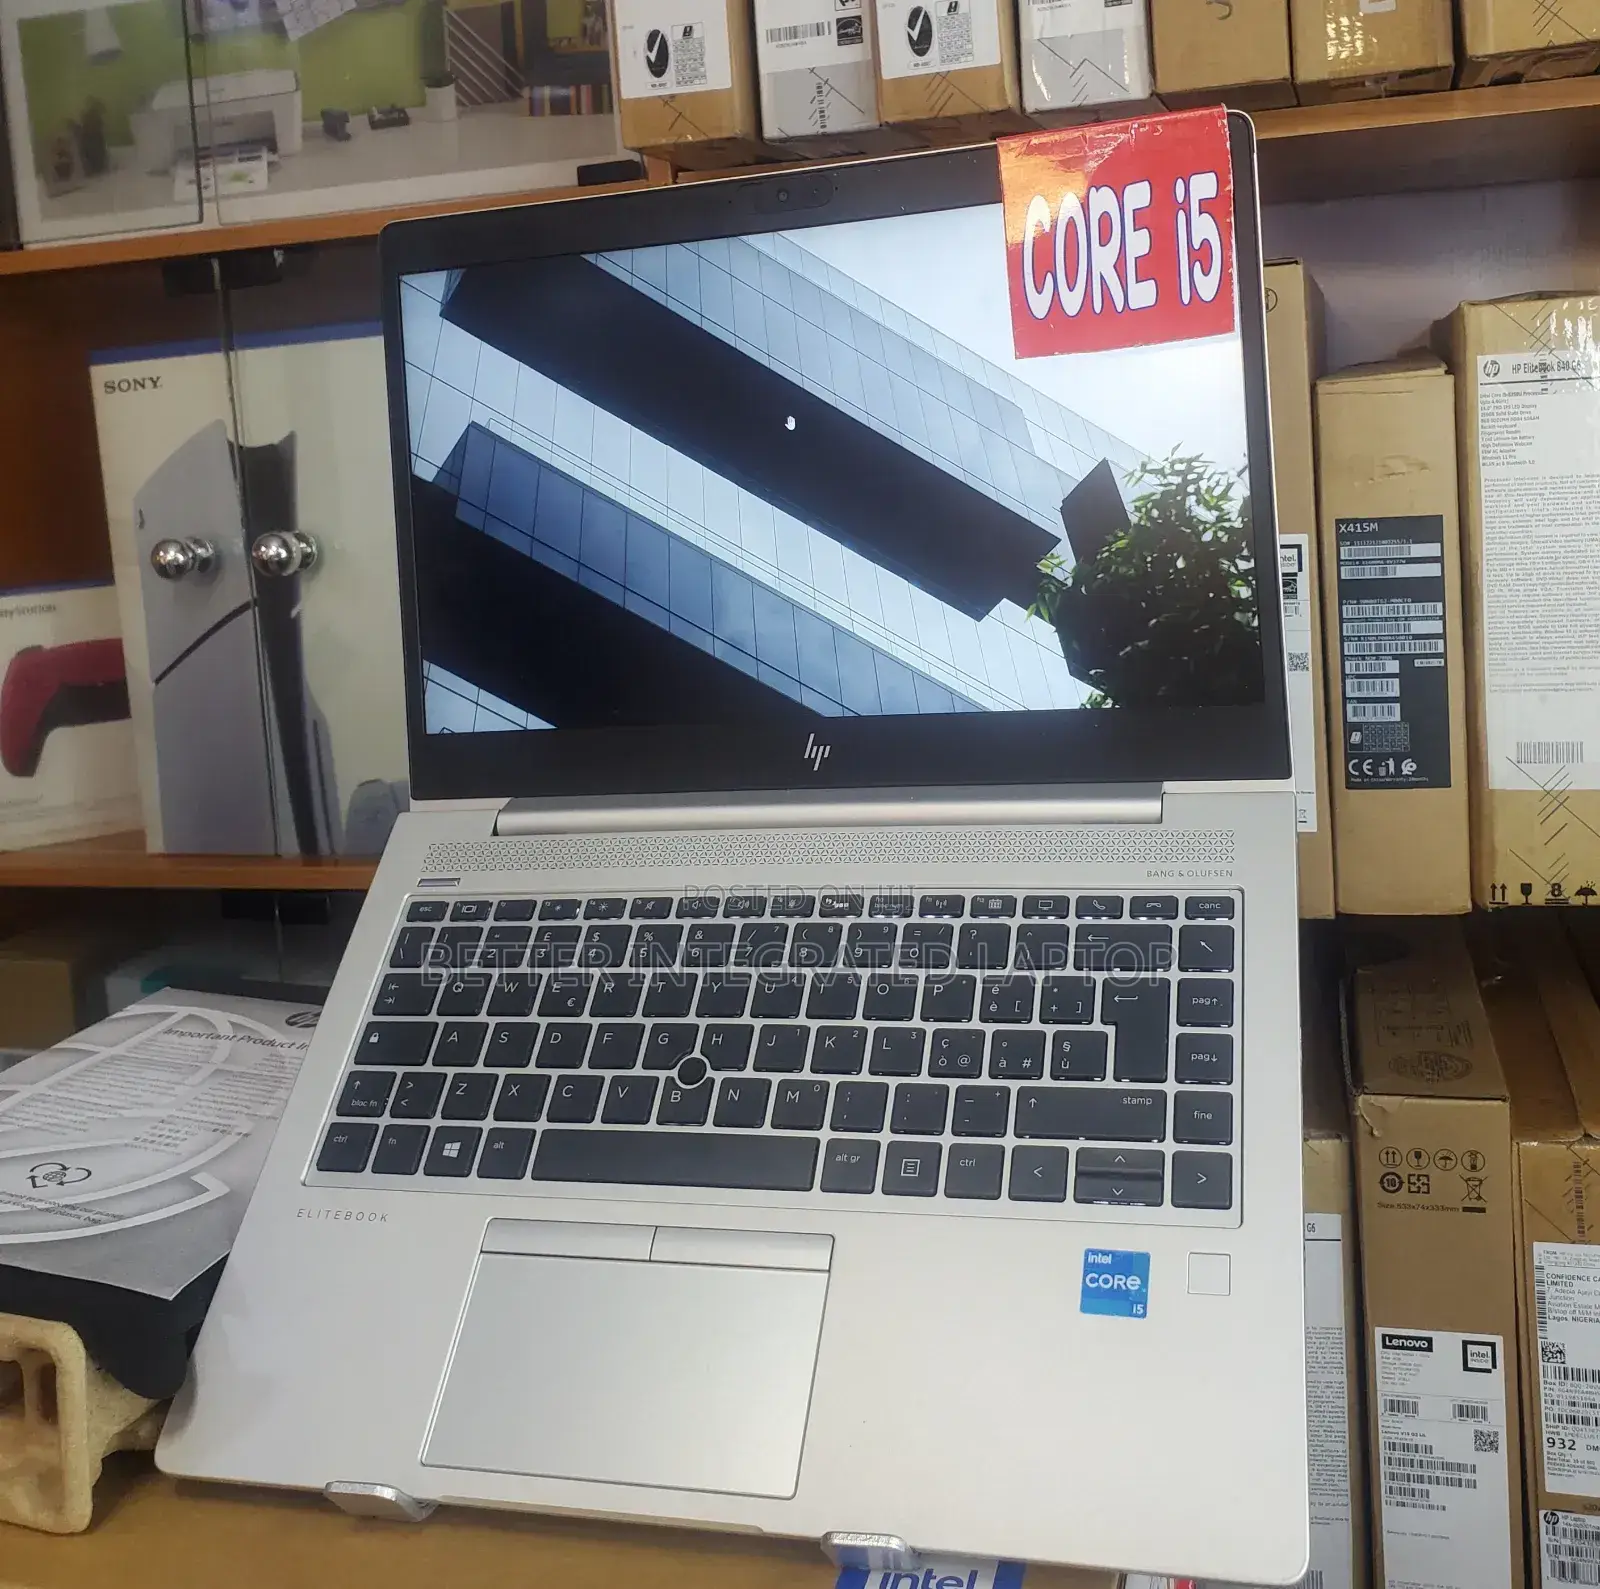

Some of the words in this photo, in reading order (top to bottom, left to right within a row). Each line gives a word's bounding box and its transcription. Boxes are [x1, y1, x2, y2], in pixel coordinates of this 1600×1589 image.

[1022, 179, 1158, 320] CORE
[1174, 171, 1222, 306] i5
[1512, 364, 1521, 374] HP
[104, 376, 162, 394] SONY
[1339, 522, 1379, 533] X415M
[1279, 554, 1296, 562] ntel.
[1146, 870, 1174, 878] BANG
[1178, 870, 1184, 878] &
[1187, 870, 1233, 878] OLUFSEN
[592, 932, 600, 943] $
[643, 931, 654, 942] %
[695, 931, 703, 939] &
[970, 930, 976, 939] ?
[453, 982, 464, 994] Q
[504, 982, 520, 993] W
[552, 982, 563, 993] E
[603, 982, 615, 993] R
[656, 982, 667, 993] T
[711, 982, 722, 993] Y
[764, 983, 776, 994] U
[933, 984, 944, 996] P
[567, 998, 576, 1006] €
[1192, 996, 1211, 1006] pag
[162, 1028, 236, 1041] Important
[237, 1035, 296, 1049] Product
[448, 1032, 457, 1042] A
[499, 1032, 509, 1043] S
[550, 1033, 561, 1043] D
[603, 1033, 613, 1043] F
[658, 1033, 668, 1044] G
[712, 1034, 723, 1044] H
[767, 1035, 775, 1046] J
[825, 1036, 836, 1047] K
[883, 1038, 891, 1049] L
[1063, 1042, 1070, 1052] §
[958, 1055, 970, 1067] @
[1022, 1058, 1031, 1068] #
[1191, 1052, 1210, 1063] pag
[456, 1083, 467, 1094] Z
[509, 1085, 520, 1096] X
[563, 1086, 573, 1097] C
[619, 1087, 628, 1098] V
[671, 1091, 681, 1102] B
[728, 1089, 739, 1100] N
[787, 1091, 799, 1102] M
[1123, 1097, 1152, 1105] stamp
[1194, 1111, 1212, 1119] fine
[835, 1153, 848, 1163] alt
[850, 1154, 861, 1164] gr
[296, 1207, 388, 1222] ELITEBOOK
[1088, 1252, 1112, 1264] intel
[1546, 1272, 1591, 1282] CONFIDENCE
[1546, 1280, 1574, 1288] LIMITED
[1385, 1336, 1428, 1348] Lenovo
[1546, 1437, 1577, 1451] 932
